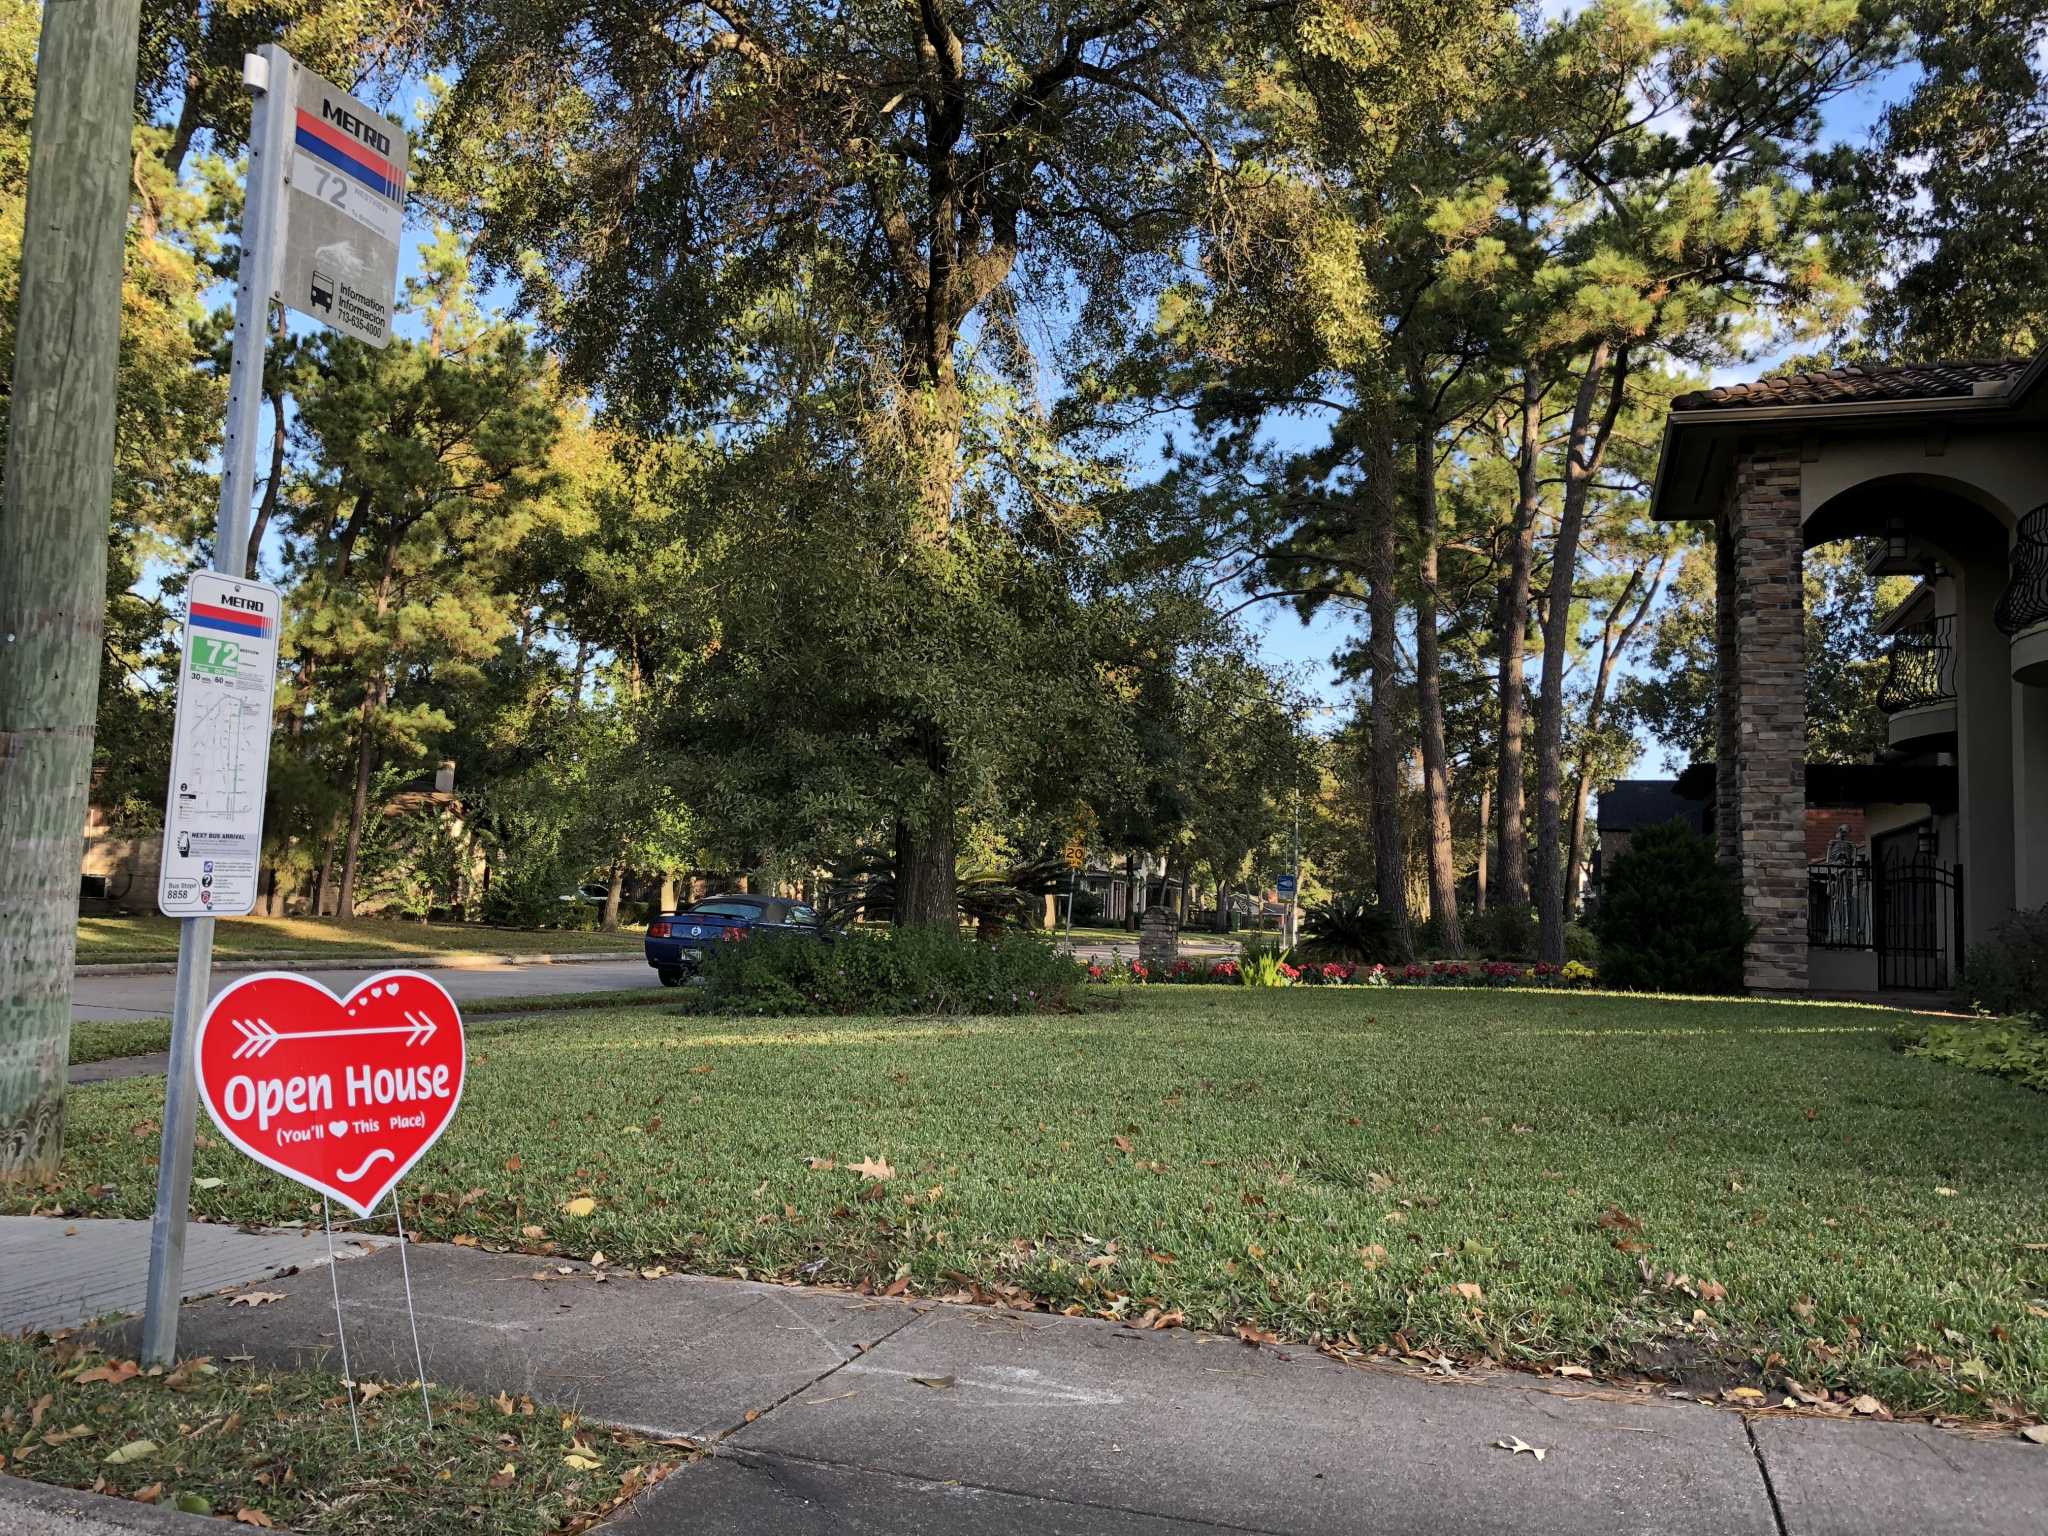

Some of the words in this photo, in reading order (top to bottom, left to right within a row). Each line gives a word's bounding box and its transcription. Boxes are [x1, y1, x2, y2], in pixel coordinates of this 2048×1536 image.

[322, 99, 390, 156] METRO
[314, 165, 347, 209] 72
[340, 282, 385, 315] Information
[338, 308, 382, 338] 713-635-4000
[221, 594, 264, 612] METRO
[207, 640, 239, 668] 72
[191, 673, 201, 681] 30
[1066, 848, 1084, 859] 20
[167, 890, 188, 899] 8858
[223, 1073, 333, 1131] Open
[346, 1064, 450, 1107] House
[352, 1118, 380, 1133] This
[390, 1111, 426, 1130] Place)
